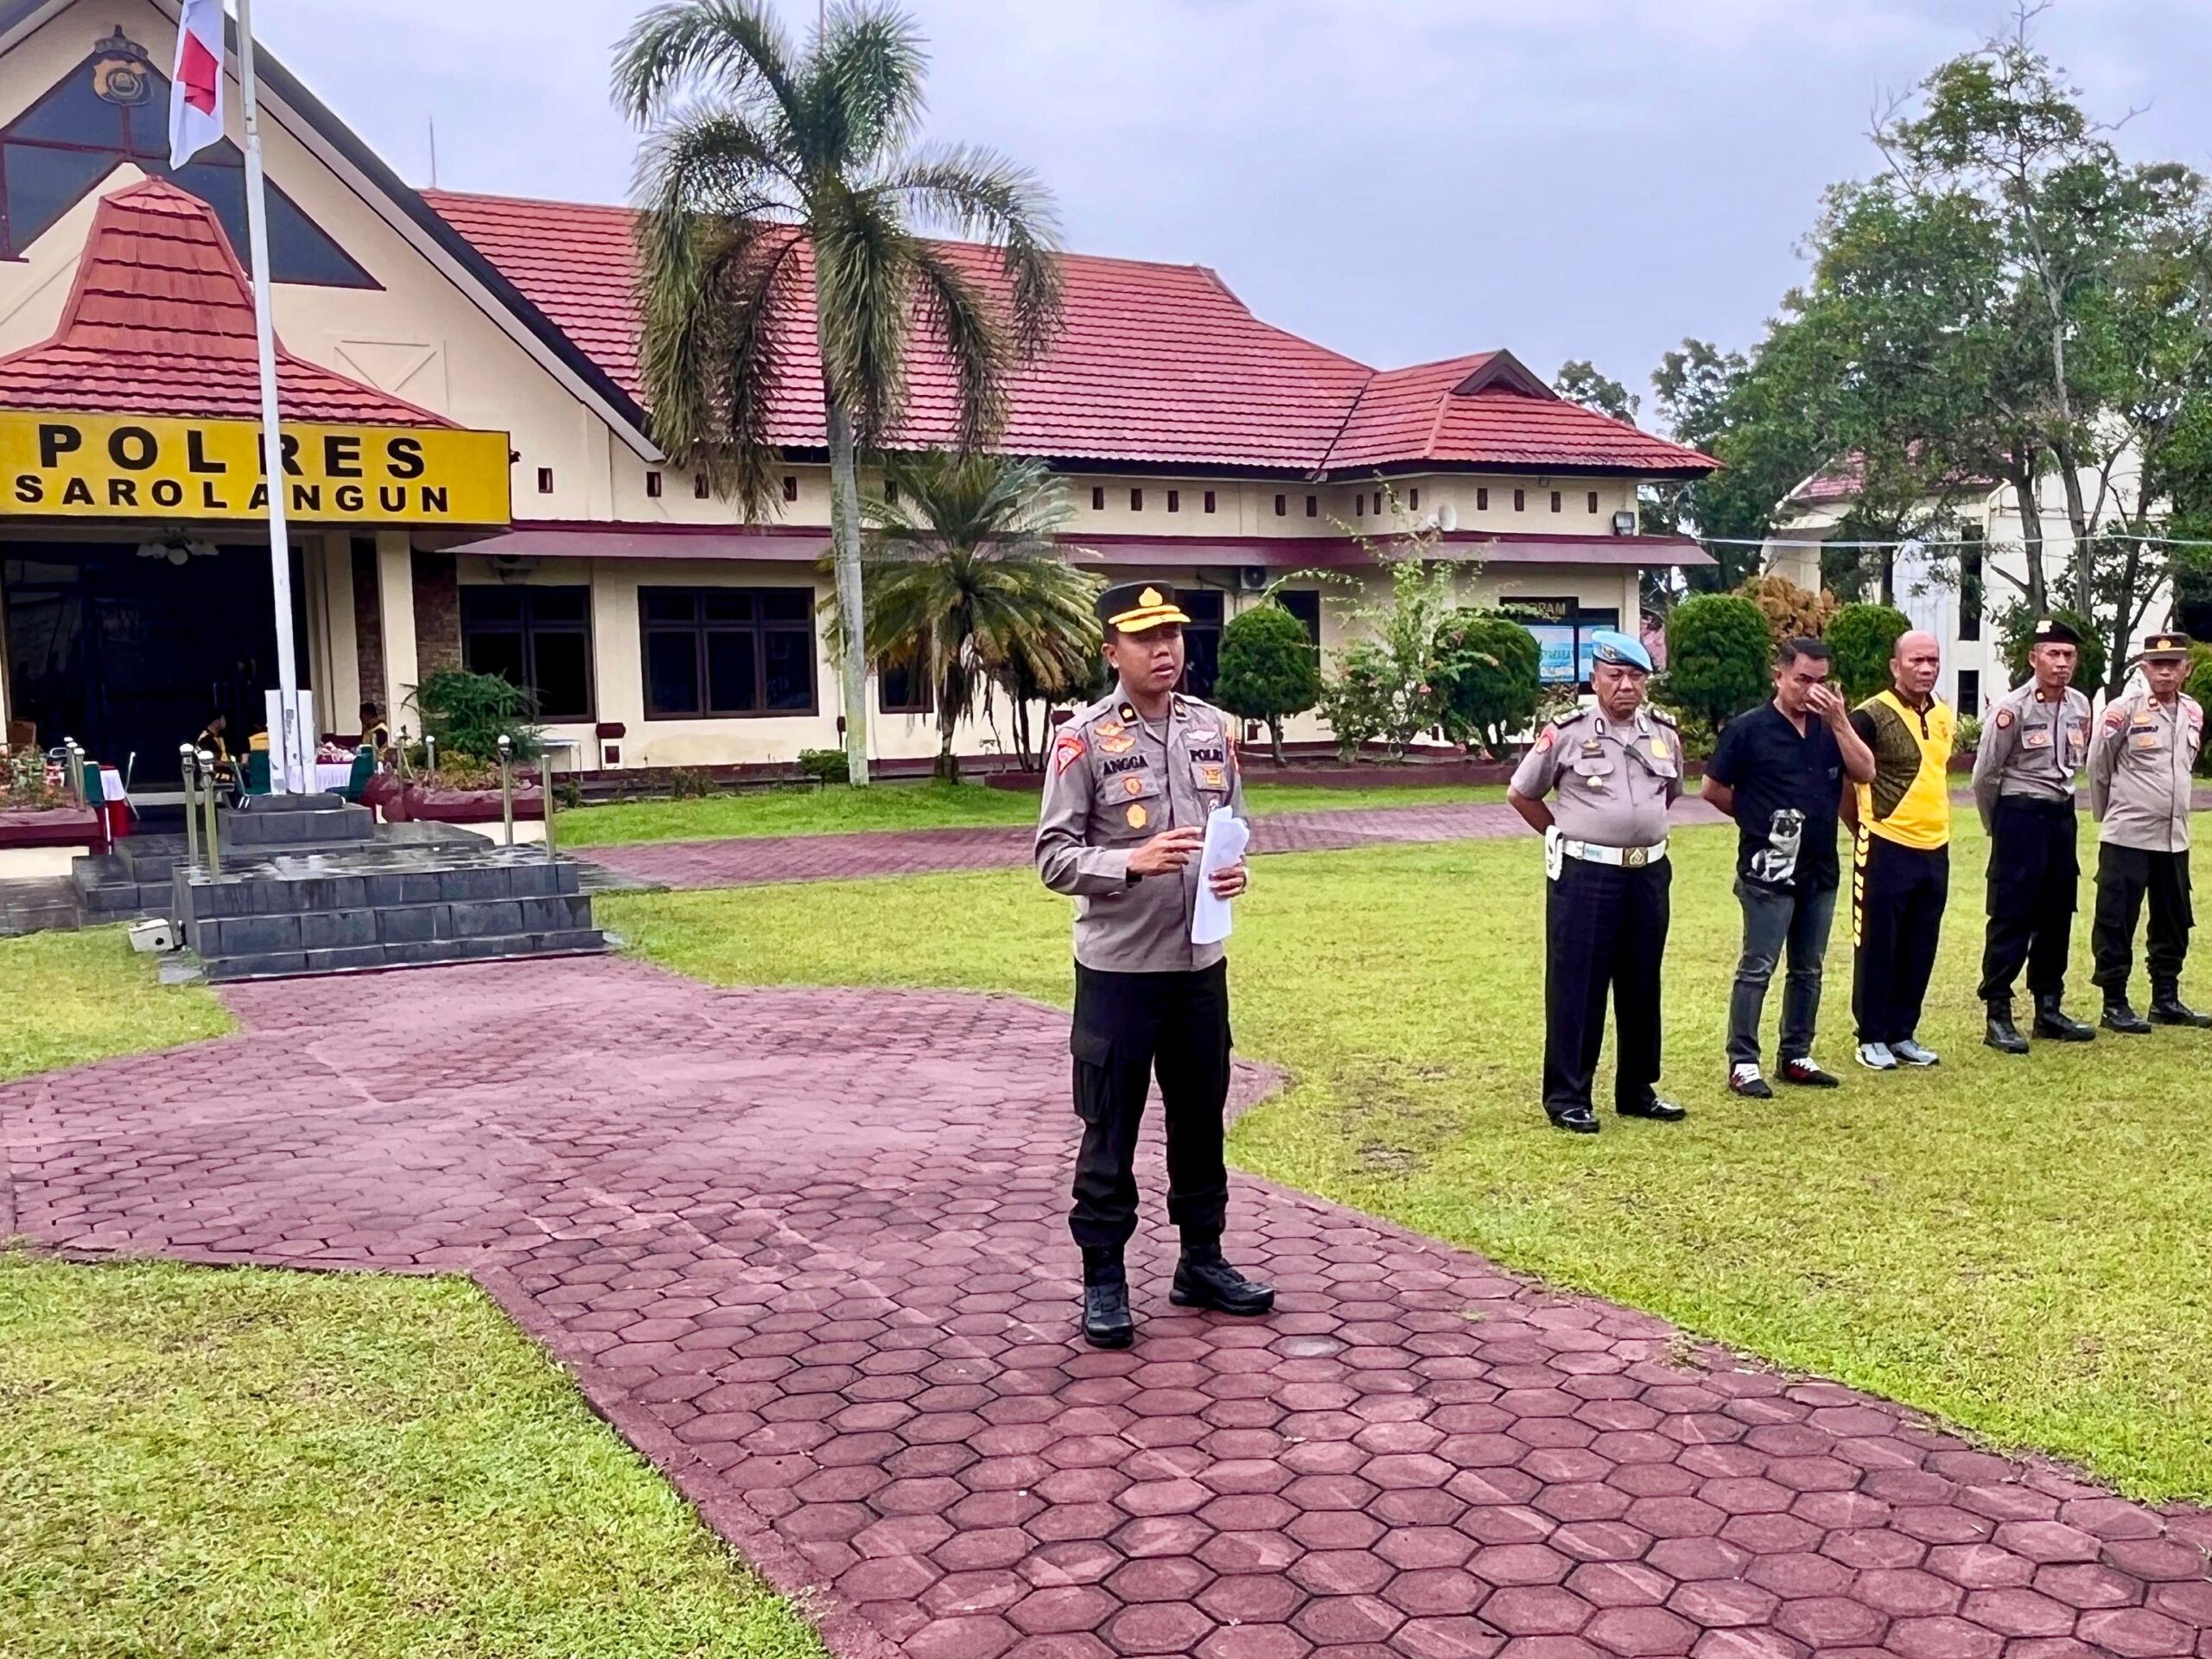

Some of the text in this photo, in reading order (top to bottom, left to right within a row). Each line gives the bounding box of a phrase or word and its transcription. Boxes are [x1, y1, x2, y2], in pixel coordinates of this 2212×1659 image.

[38, 423, 425, 479] POLRES
[15, 474, 448, 512] SAROLANGUN
[1103, 754, 1148, 775] ANGGA
